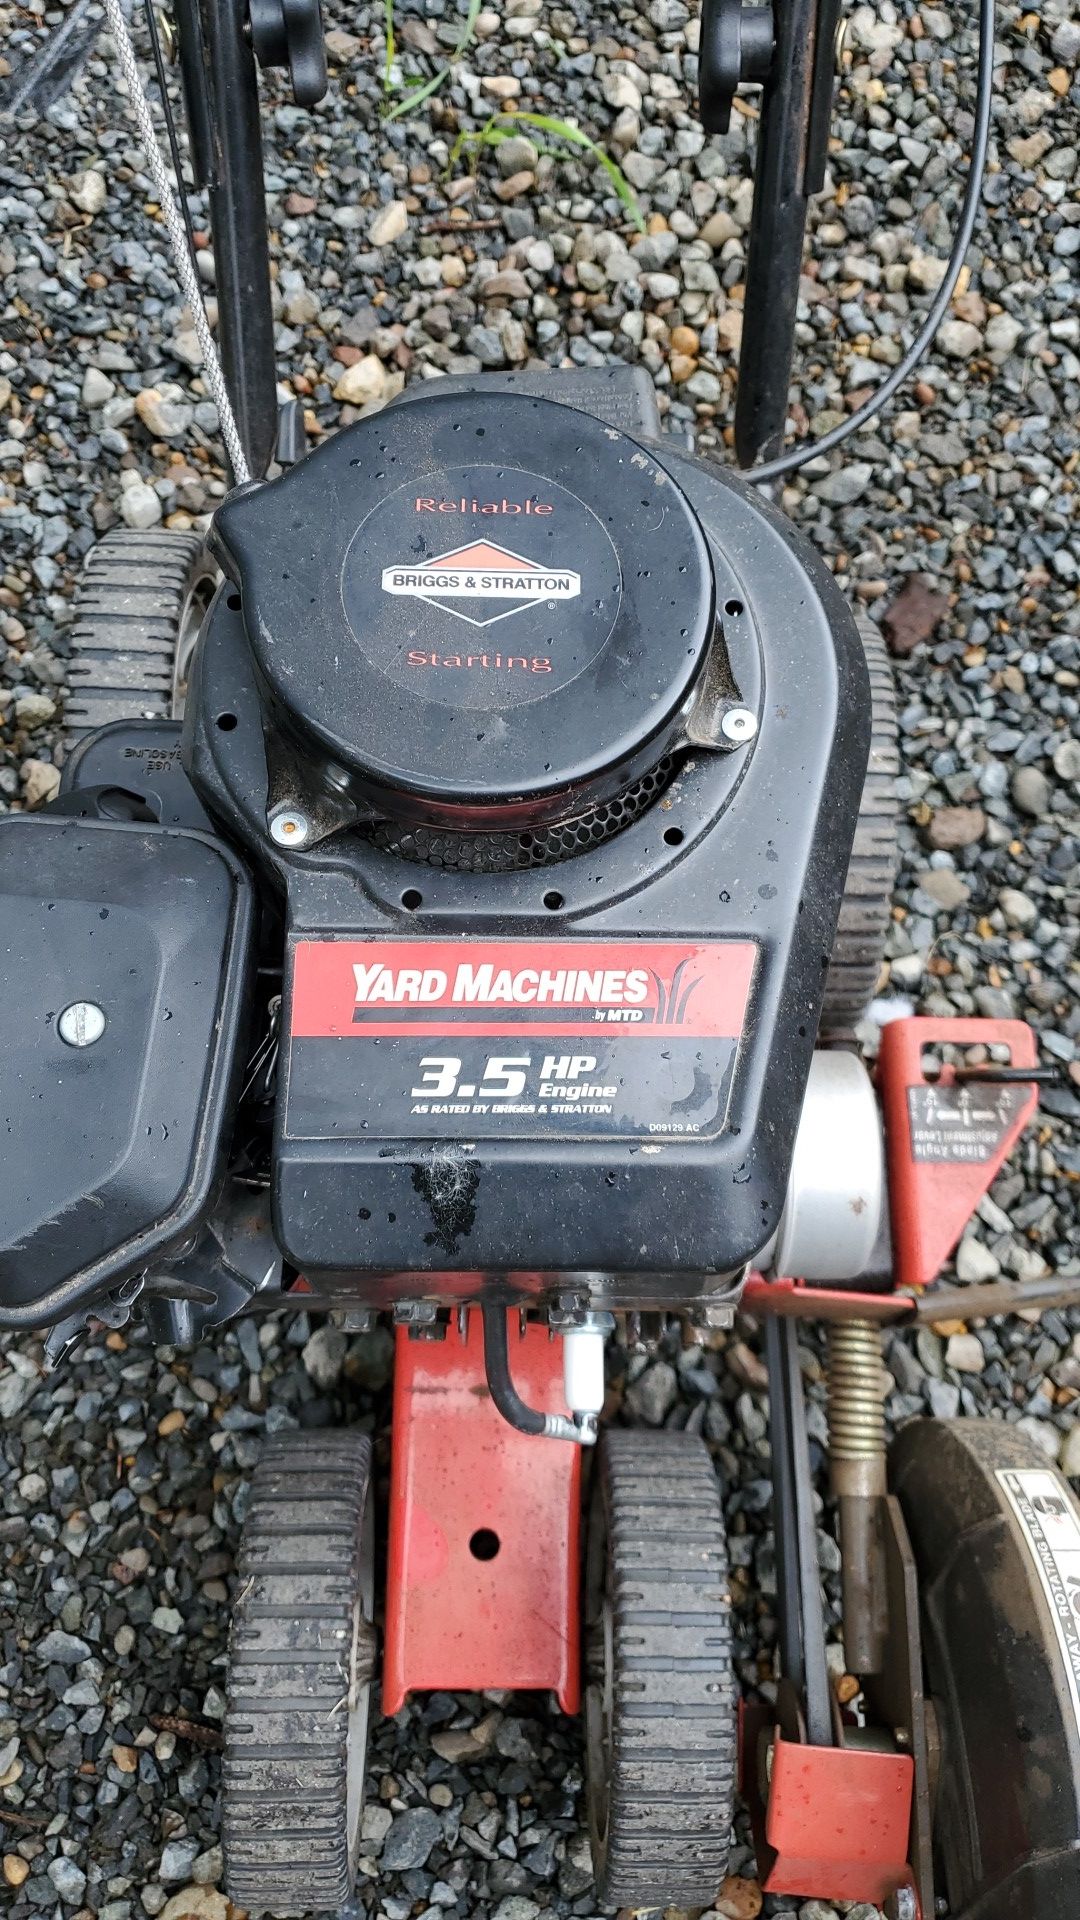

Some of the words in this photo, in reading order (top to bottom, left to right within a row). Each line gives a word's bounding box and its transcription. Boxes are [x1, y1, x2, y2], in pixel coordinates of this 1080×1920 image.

[415, 497, 553, 515] Reliable
[392, 574, 460, 588] BRIGGS
[464, 576, 477, 589] &
[481, 576, 570, 591] STRATTON
[406, 651, 552, 674] Starting
[352, 963, 448, 1002] YARD
[454, 963, 649, 1003] MACHINES
[594, 1010, 606, 1021] by
[607, 1009, 644, 1022] MTD
[539, 1055, 597, 1080] HP
[411, 1056, 532, 1098] 3.5
[538, 1083, 618, 1101] Engine
[410, 1105, 429, 1114] AS
[430, 1105, 470, 1114] RATED
[472, 1105, 490, 1114] BY
[491, 1105, 536, 1114] BRIGGS
[537, 1105, 548, 1114] &
[550, 1105, 613, 1114] STRATTON
[649, 1123, 684, 1132] D09129
[685, 1123, 700, 1132] AC
